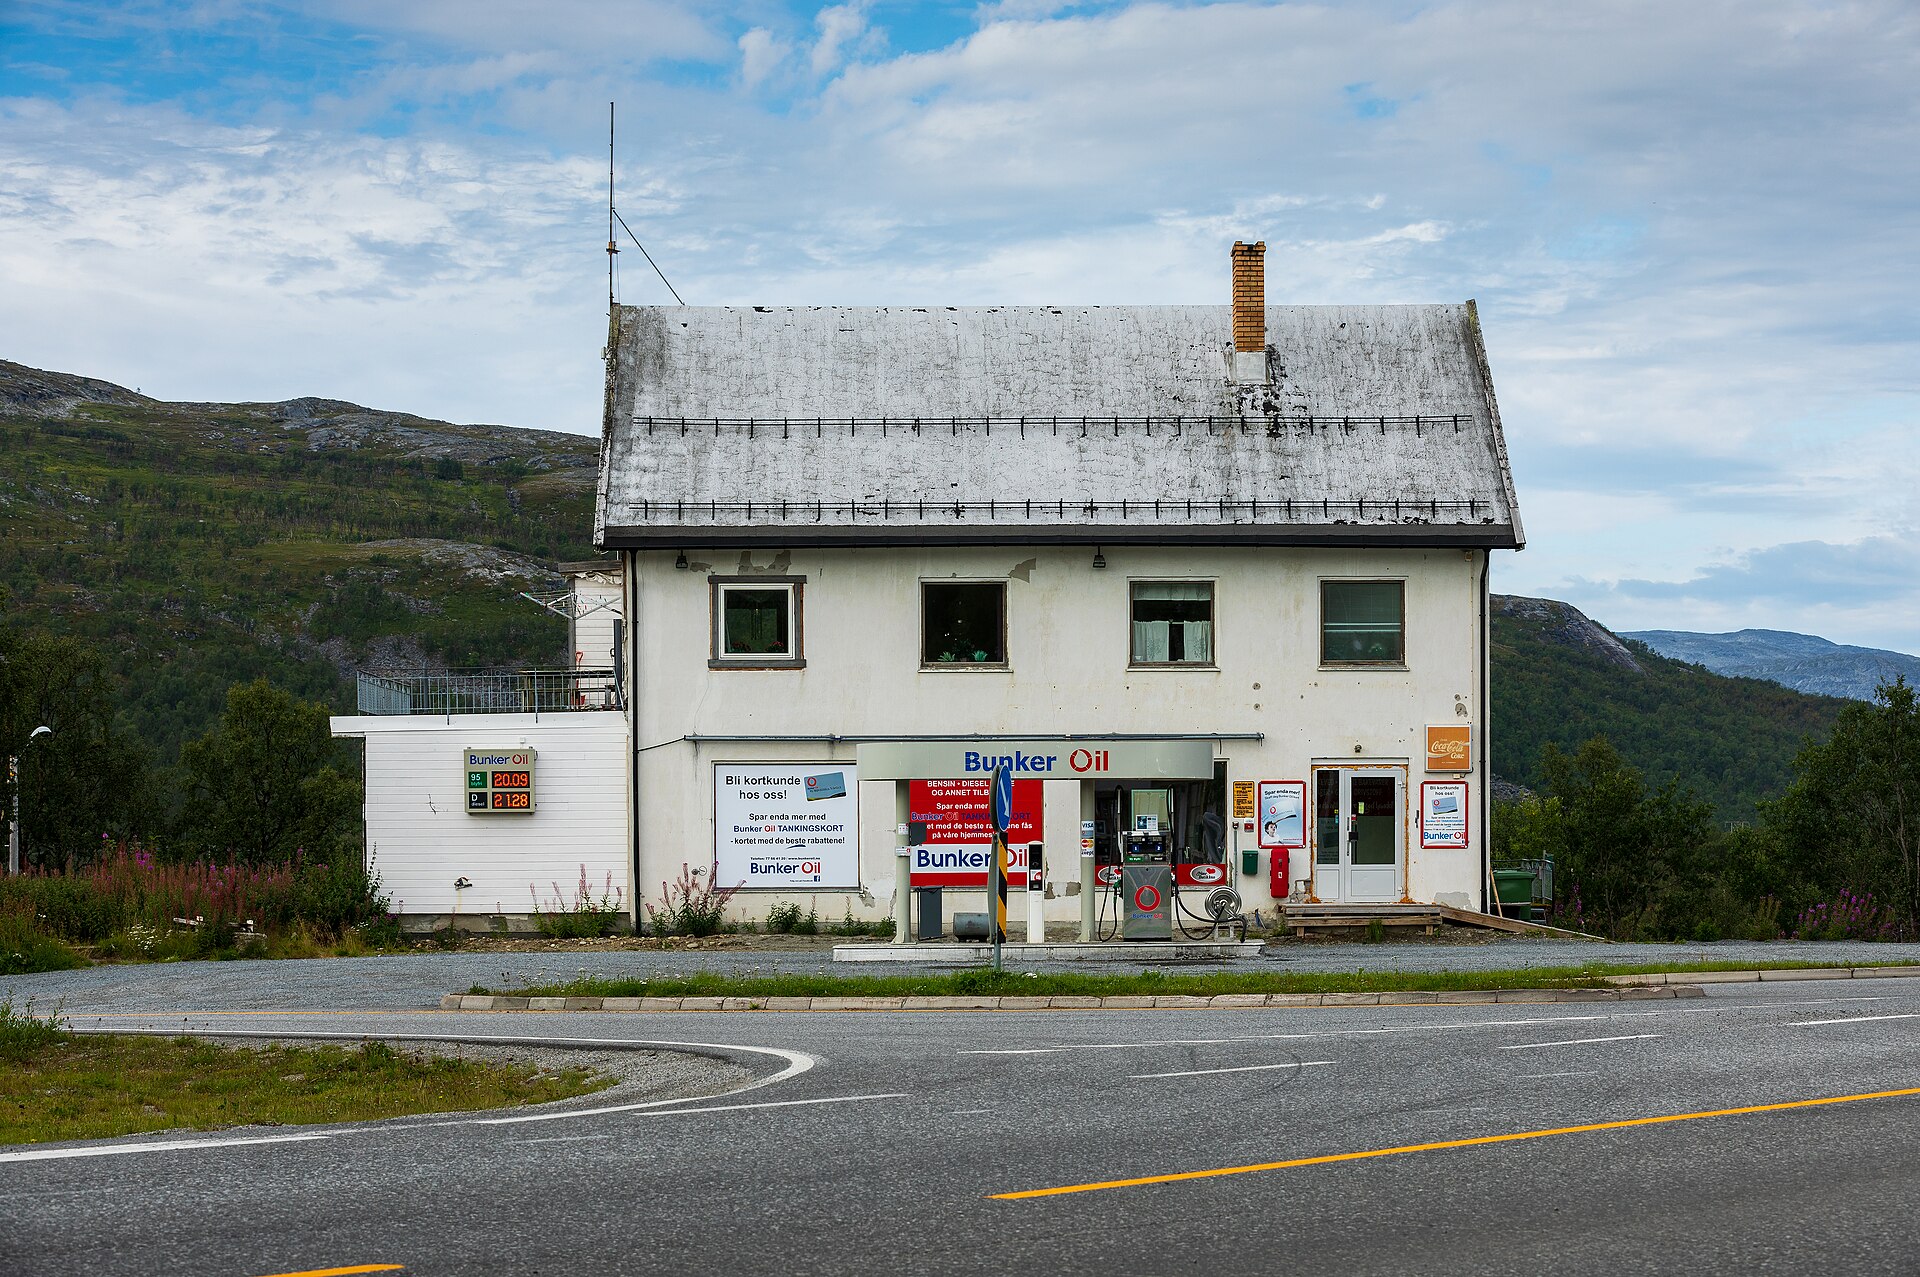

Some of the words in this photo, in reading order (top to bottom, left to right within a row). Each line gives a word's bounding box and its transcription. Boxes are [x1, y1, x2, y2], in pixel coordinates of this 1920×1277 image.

[1432, 740, 1464, 752] Coca-Cola
[470, 754, 510, 765] Bunker
[512, 754, 528, 764] Oil
[964, 751, 1056, 772] Bunker
[1070, 748, 1108, 772] Oil
[494, 773, 528, 786] 20.09
[726, 776, 740, 785] Bli
[744, 776, 800, 785] kortkunde
[740, 790, 759, 799] hos
[763, 790, 787, 799] oss!
[912, 812, 944, 820] Bunker
[917, 849, 991, 867] Bunker
[751, 863, 799, 874] Bunker
[801, 862, 820, 874] Oil
